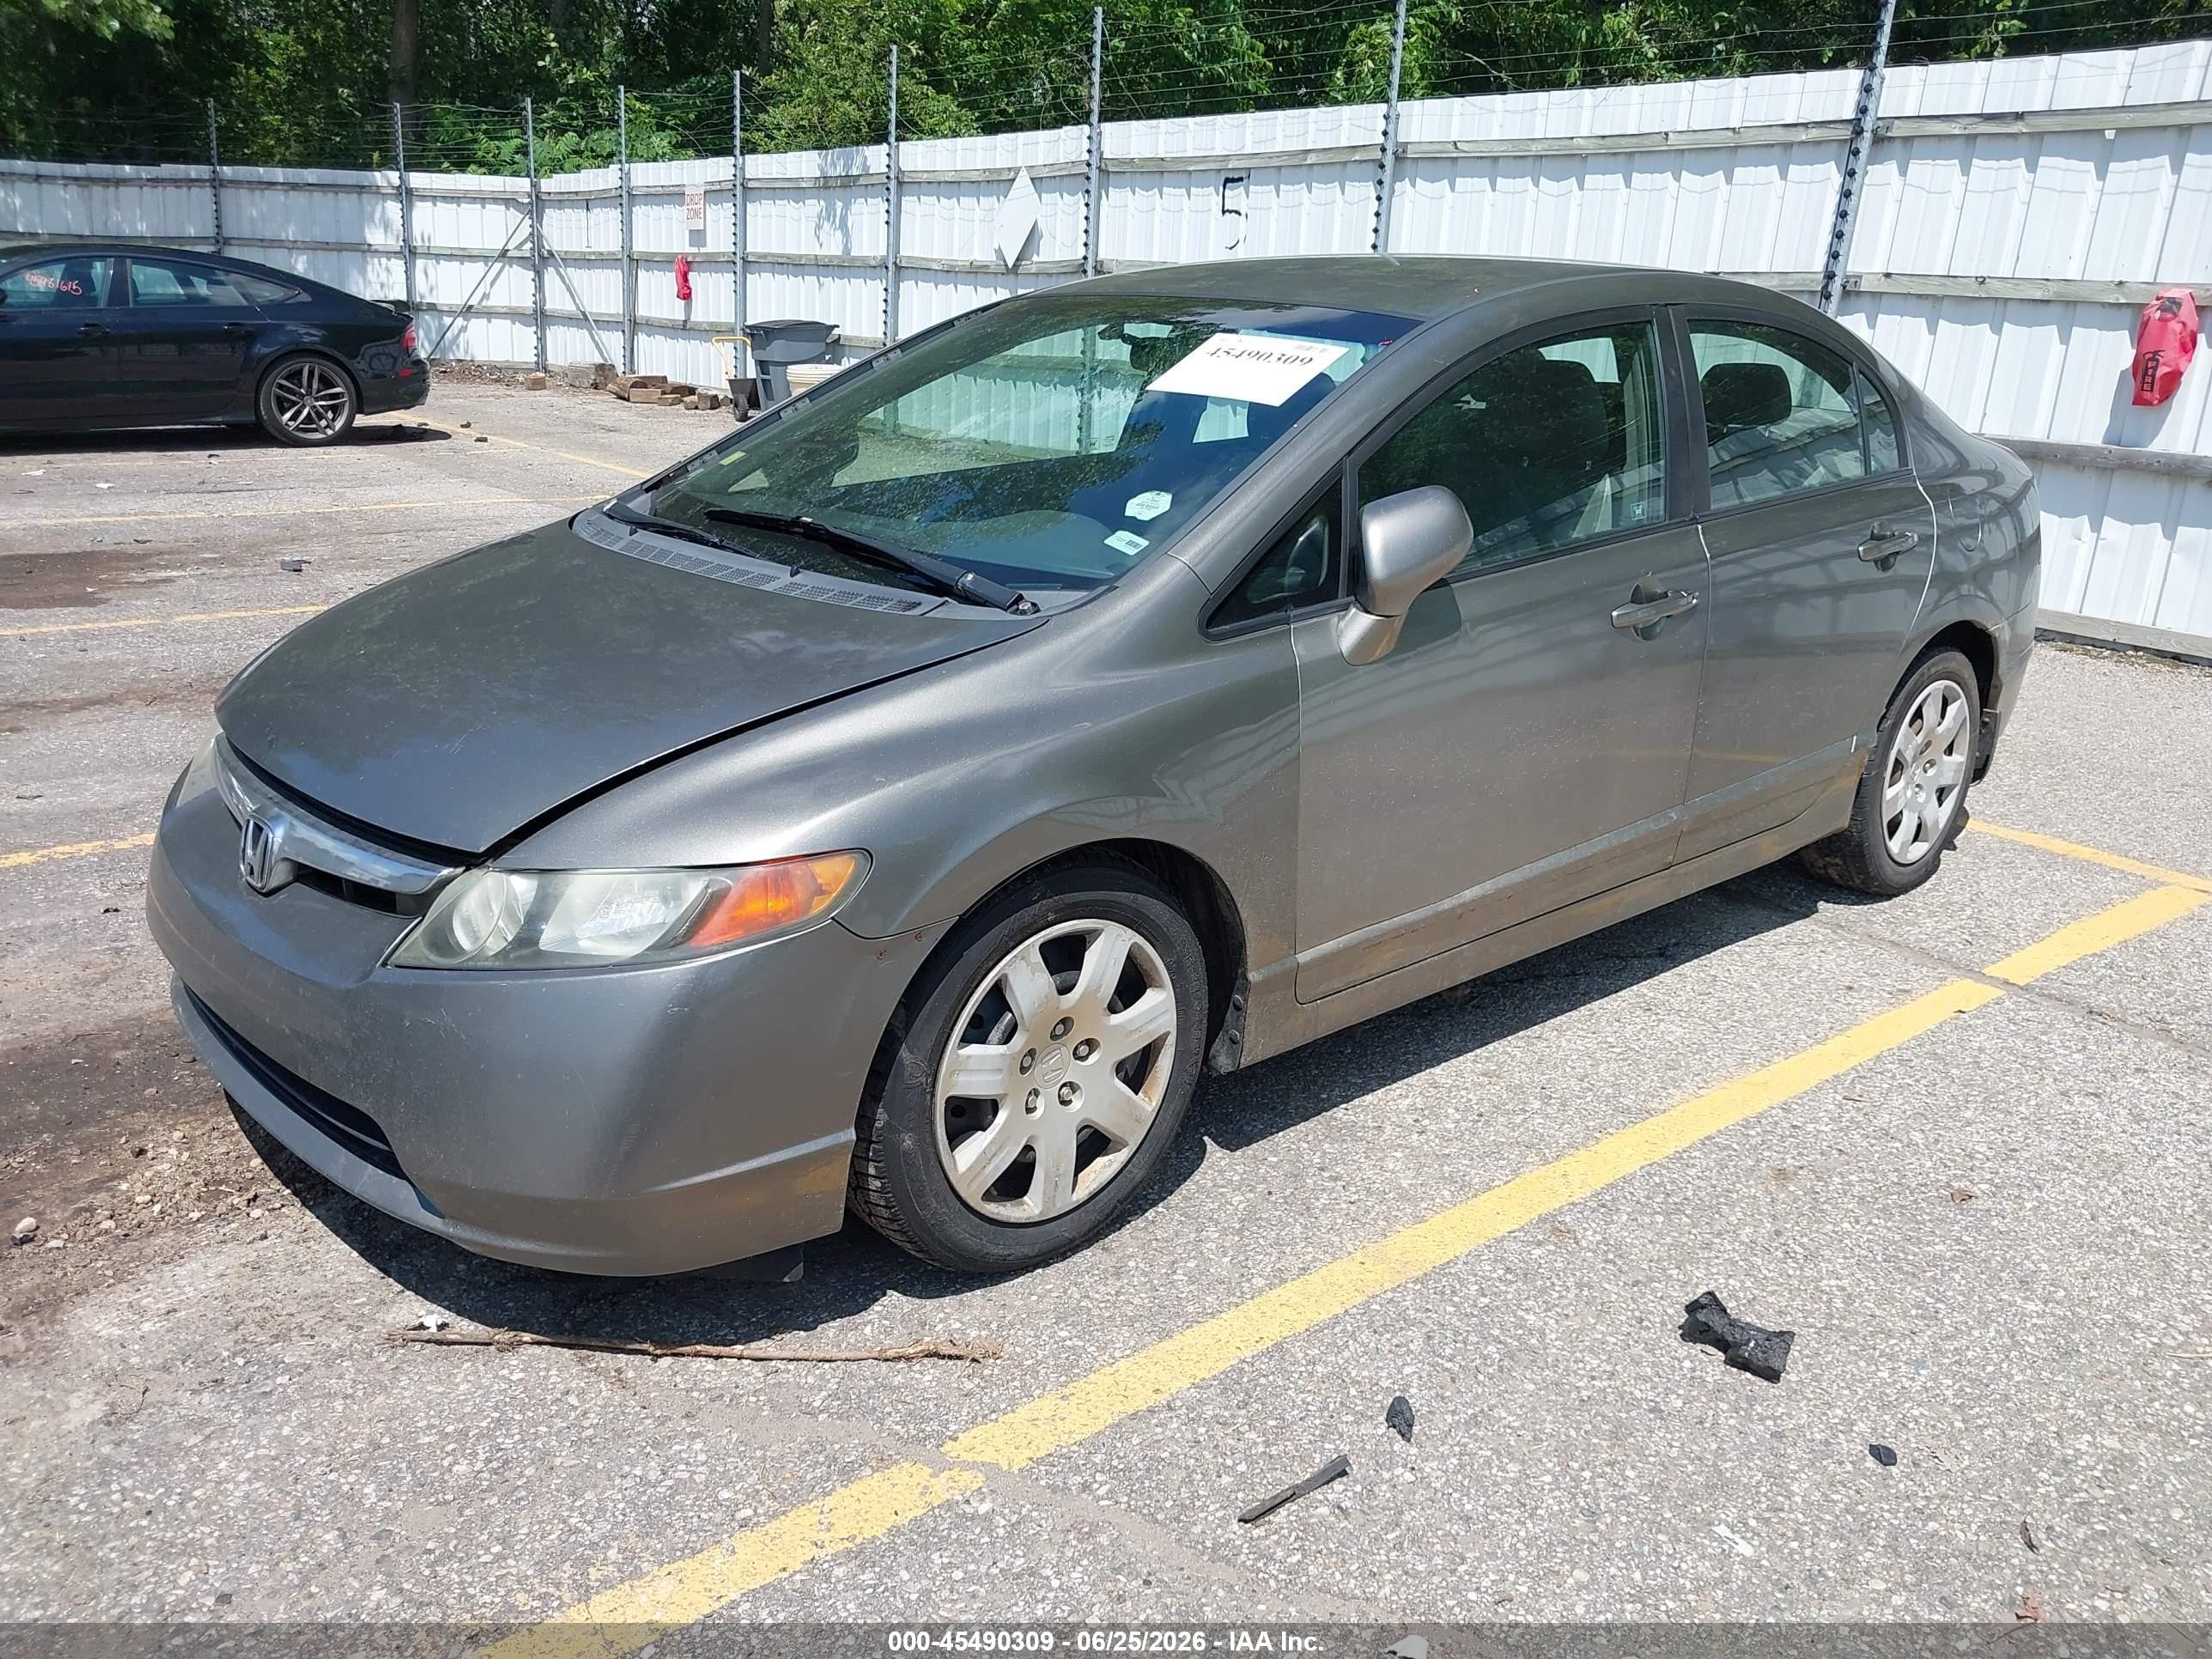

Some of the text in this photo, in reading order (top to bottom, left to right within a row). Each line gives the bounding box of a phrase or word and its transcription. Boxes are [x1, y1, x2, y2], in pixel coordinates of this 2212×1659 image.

[686, 192, 703, 206] DROP
[686, 207, 703, 221] ZONE
[1221, 170, 1249, 251] 5
[1205, 347, 1314, 367] 45490309
[2142, 361, 2157, 391] FIRE
